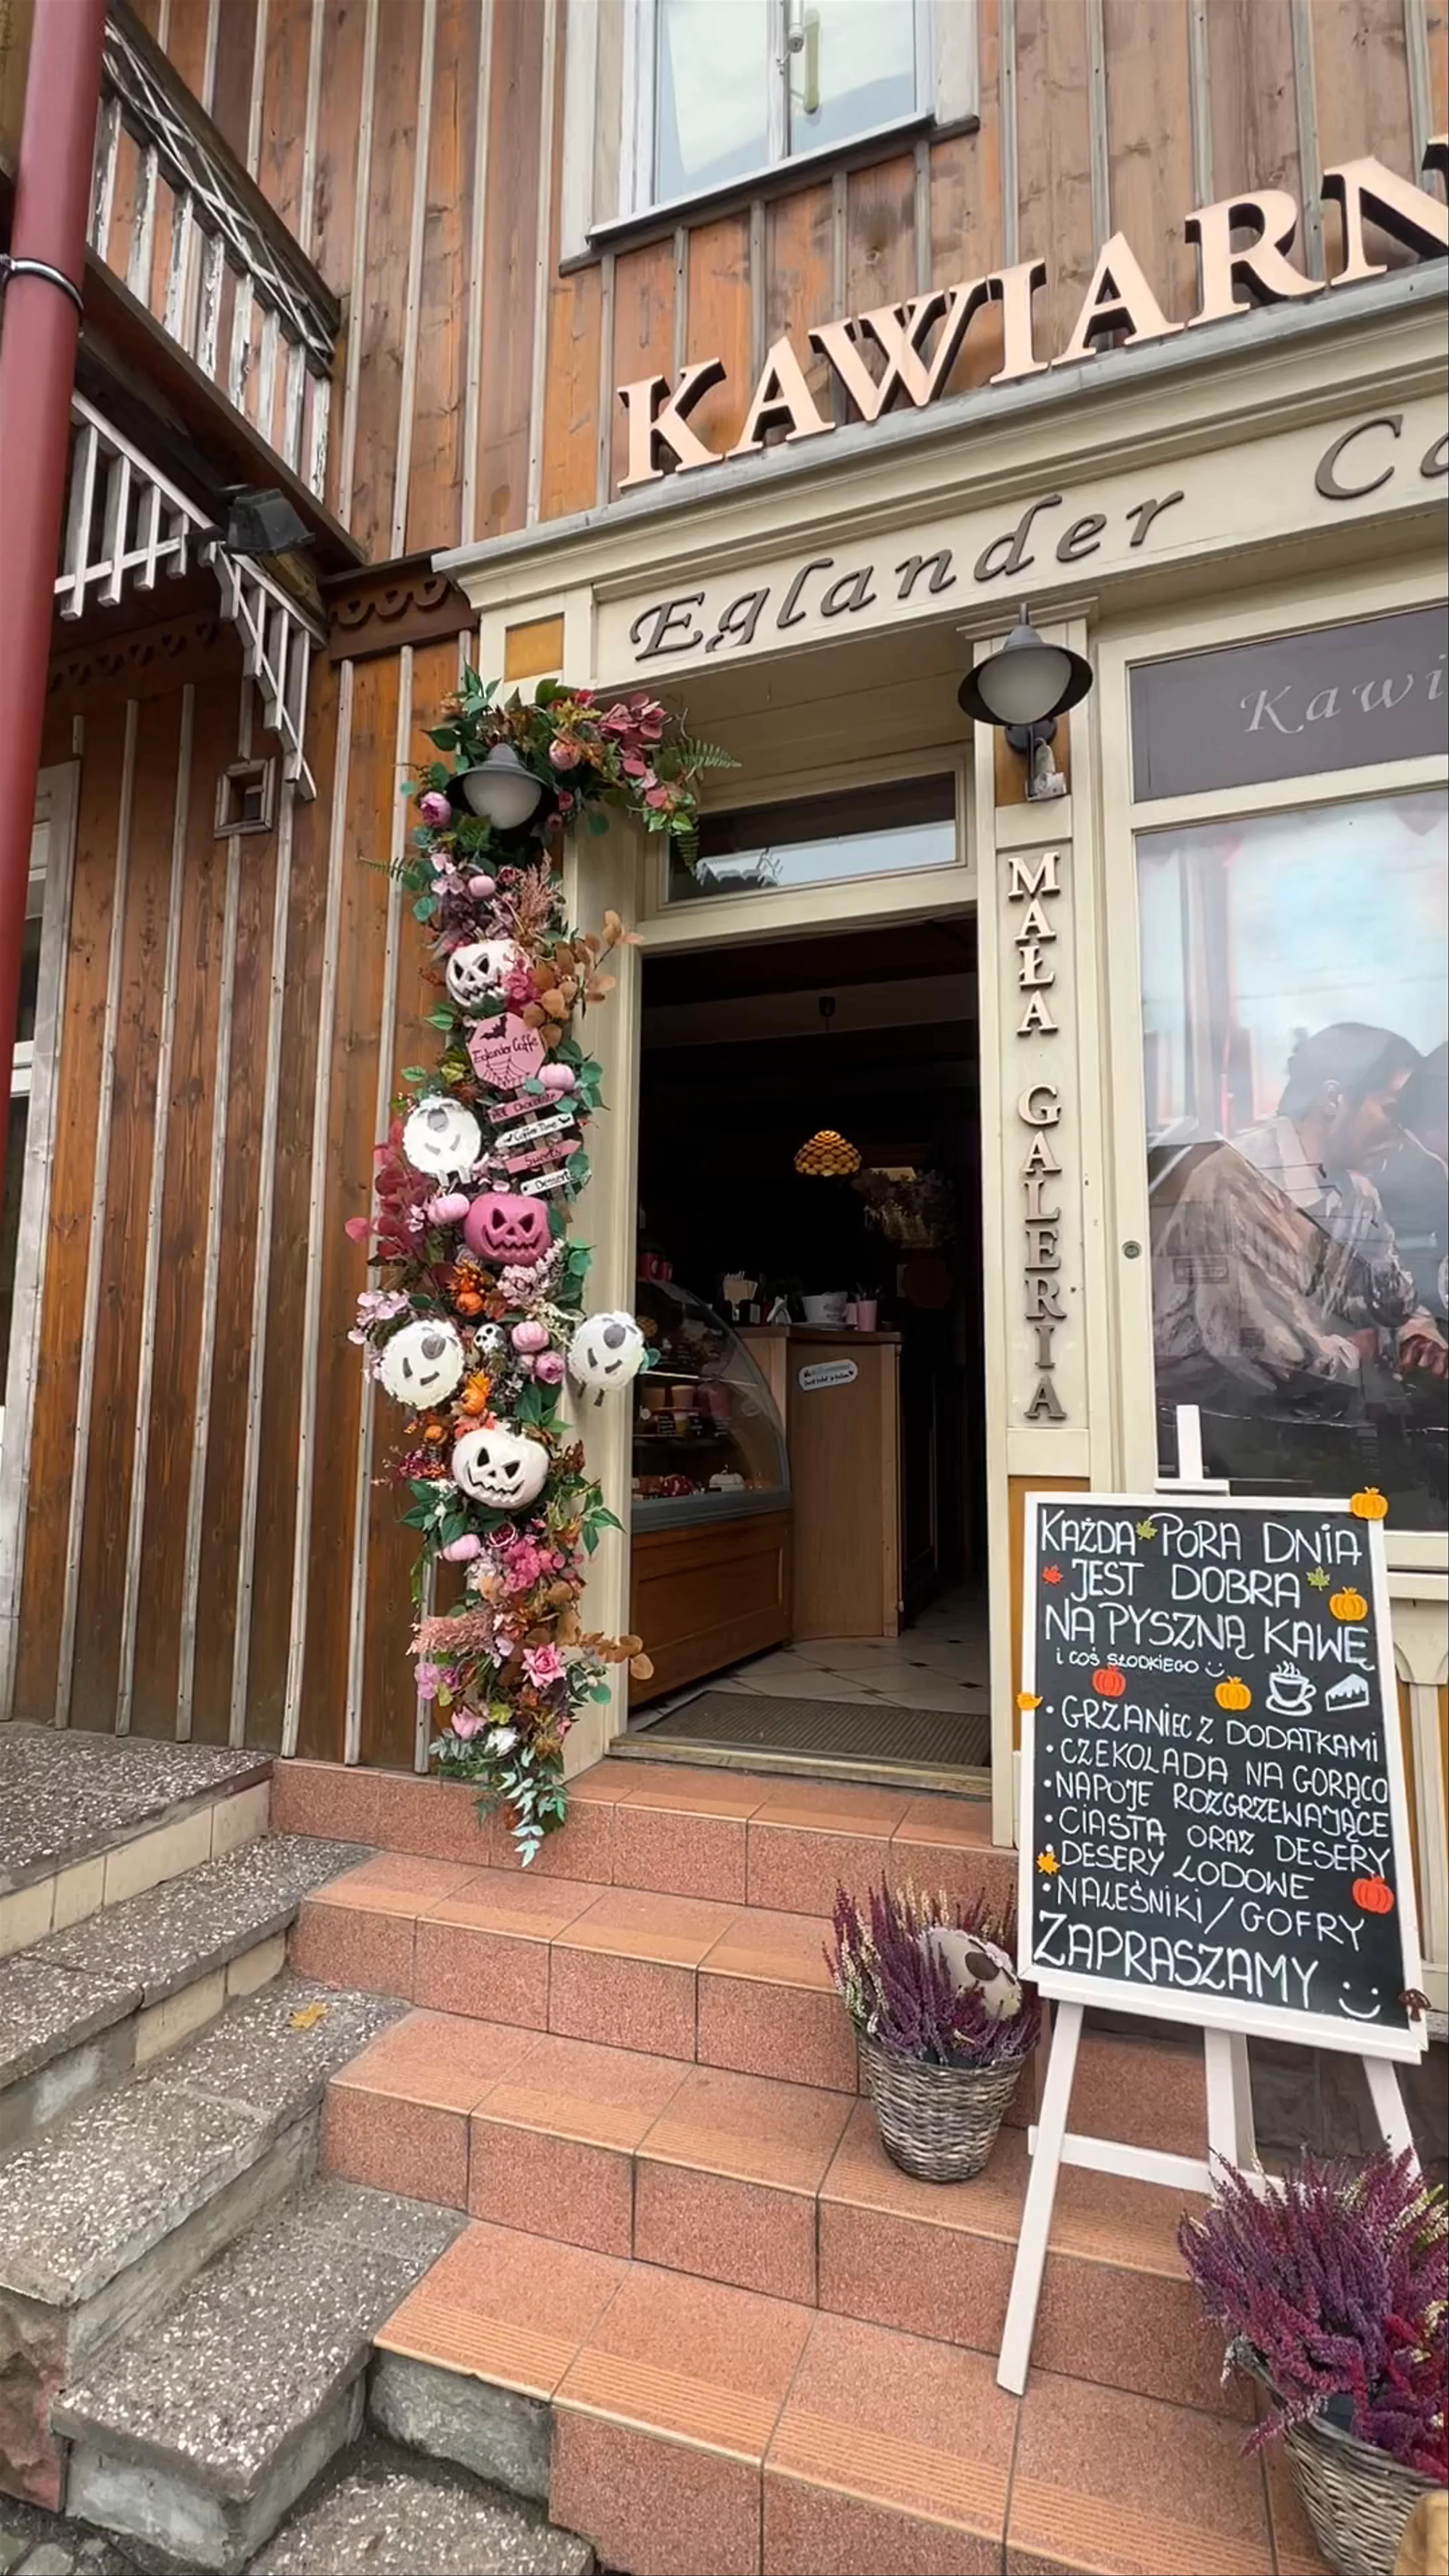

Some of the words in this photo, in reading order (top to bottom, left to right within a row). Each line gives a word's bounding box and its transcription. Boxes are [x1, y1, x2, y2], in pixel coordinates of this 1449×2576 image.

[629, 489, 1185, 662] Eglander
[1240, 653, 1447, 734] Kawi
[1008, 851, 1060, 1037] MAŁA
[525, 1148, 561, 1166] Sweets
[1017, 1084, 1068, 1420] GALERIA
[1042, 1509, 1135, 1556] KAŻDA
[1148, 1512, 1241, 1560] PORA
[1070, 1558, 1145, 1602] JEST
[1172, 1563, 1300, 1609] DOBRA
[1045, 1598, 1095, 1644] NA
[1098, 1602, 1255, 1659] PYSZNĄ
[1264, 1616, 1376, 1671] KAWĘ
[1196, 1716, 1214, 1745] Z
[1056, 1770, 1154, 1812] NAPOJE
[1173, 1782, 1389, 1842] ROZGRZEWAJĄCE
[1060, 1738, 1228, 1785] CZEKOLADA
[1246, 1760, 1283, 1790] NA
[1293, 1765, 1388, 1809] GORĄCO
[1061, 1840, 1165, 1877] DESERY
[1172, 1855, 1315, 1900] LODOWE
[1186, 1825, 1255, 1856] ORAZ
[1274, 1835, 1391, 1879] DESERY
[1033, 1910, 1319, 2009] ZAPRASZAMY
[1240, 1902, 1365, 1952] GOFRY
